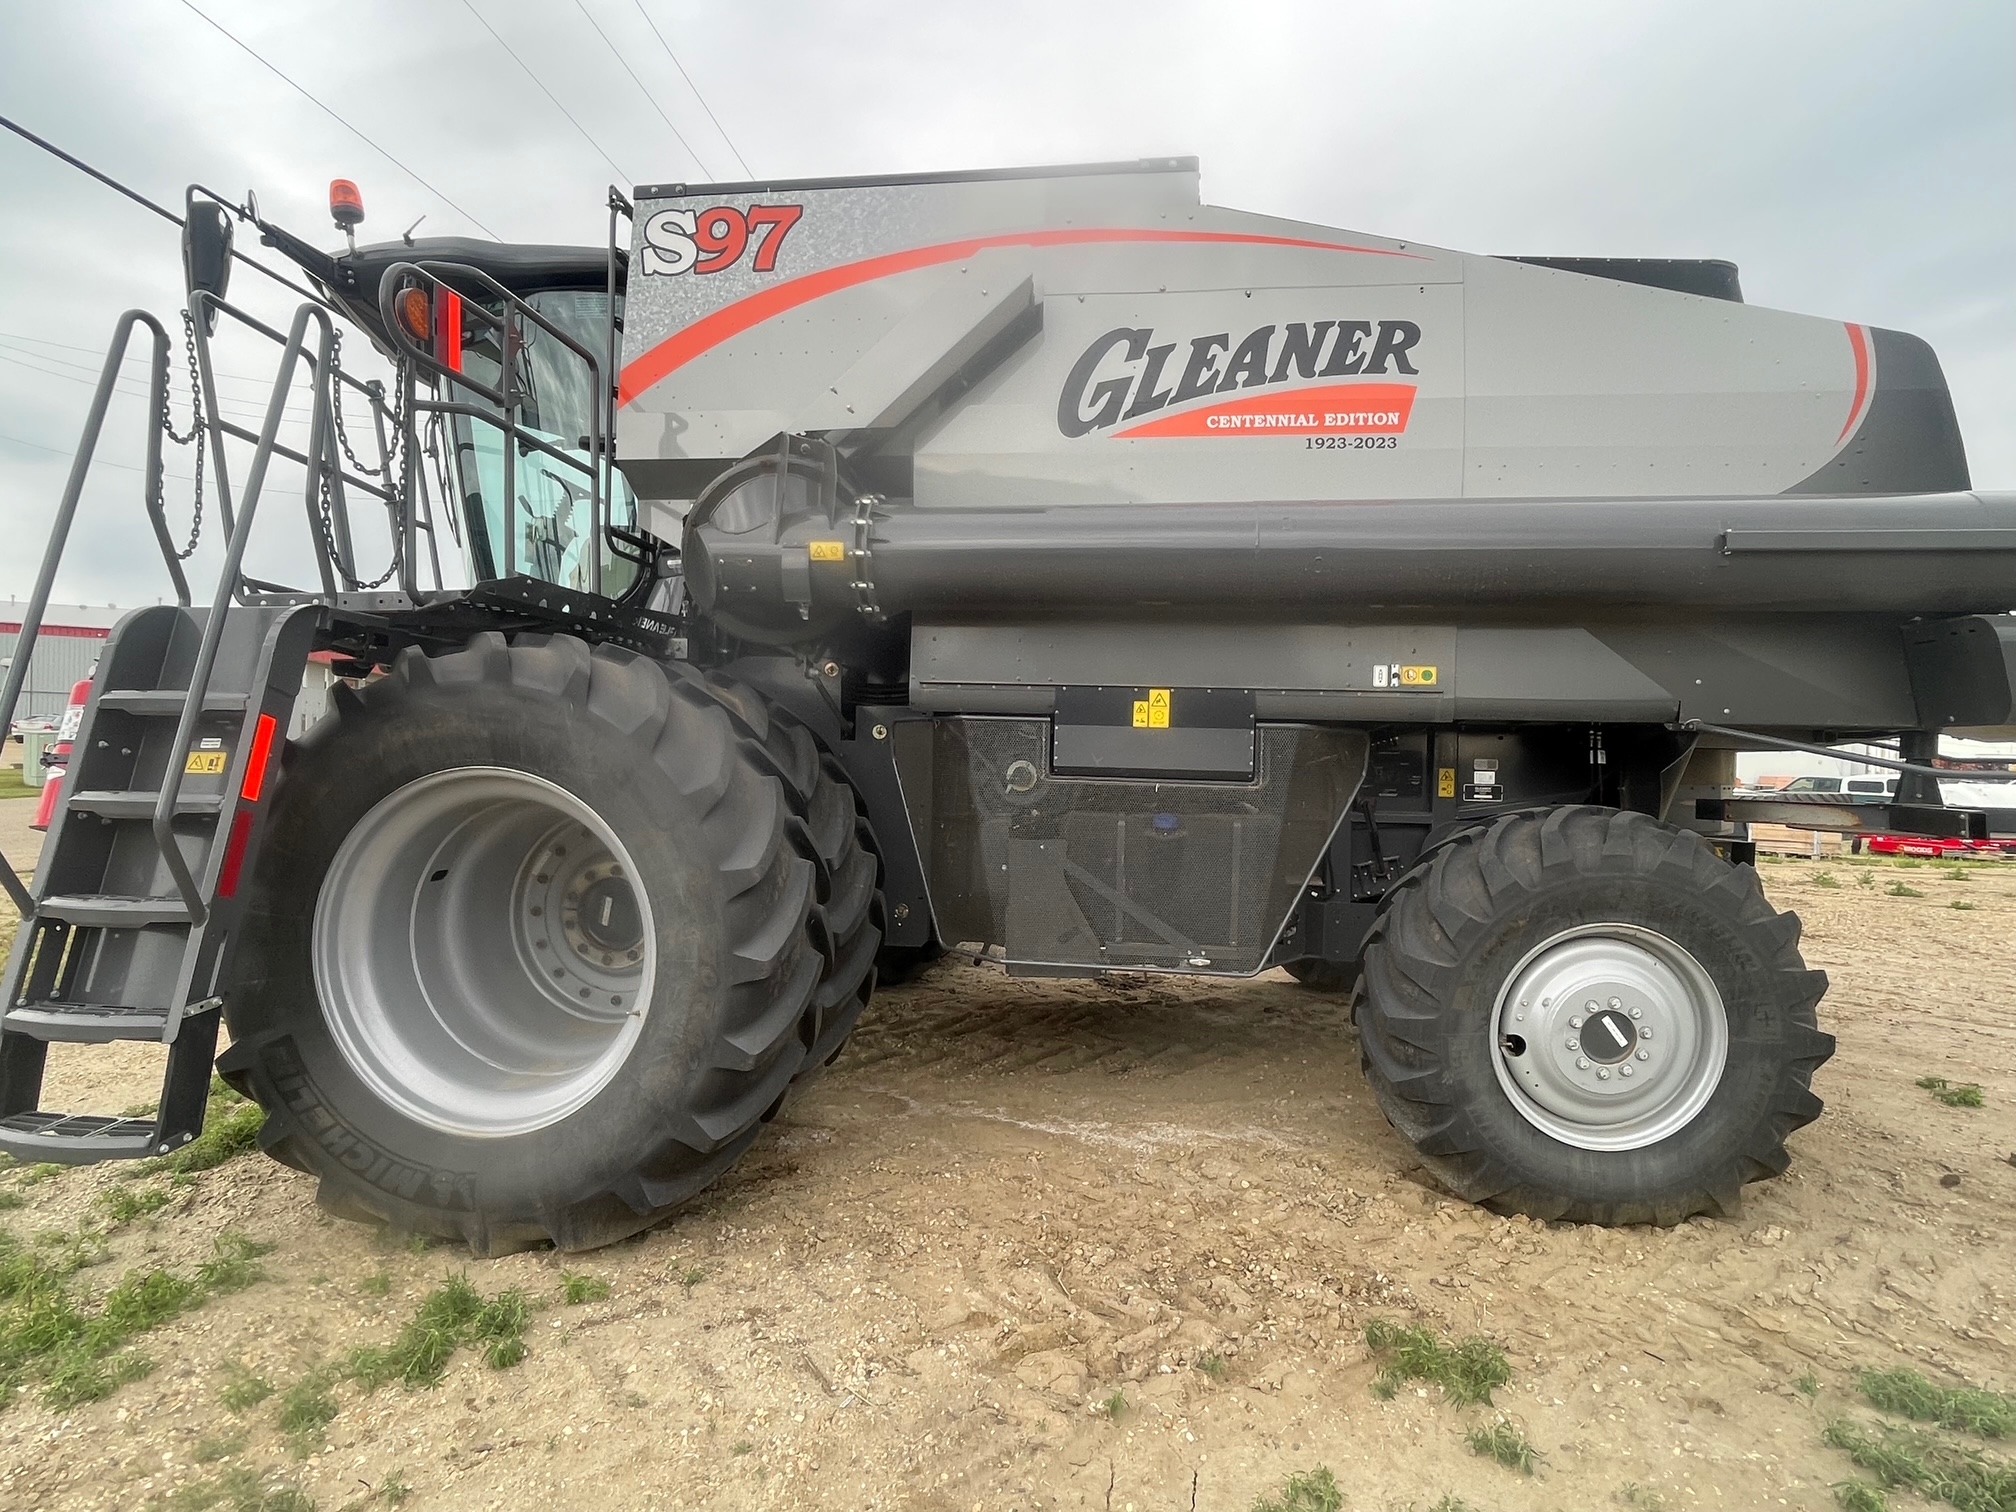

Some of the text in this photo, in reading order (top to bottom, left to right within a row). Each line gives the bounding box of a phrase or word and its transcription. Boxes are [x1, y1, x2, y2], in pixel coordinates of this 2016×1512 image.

[641, 204, 803, 277] S97
[1057, 320, 1421, 438] GLEANER
[1206, 412, 1400, 428] CENTENNIAL EDITION
[1305, 437, 1397, 449] 1923-2023
